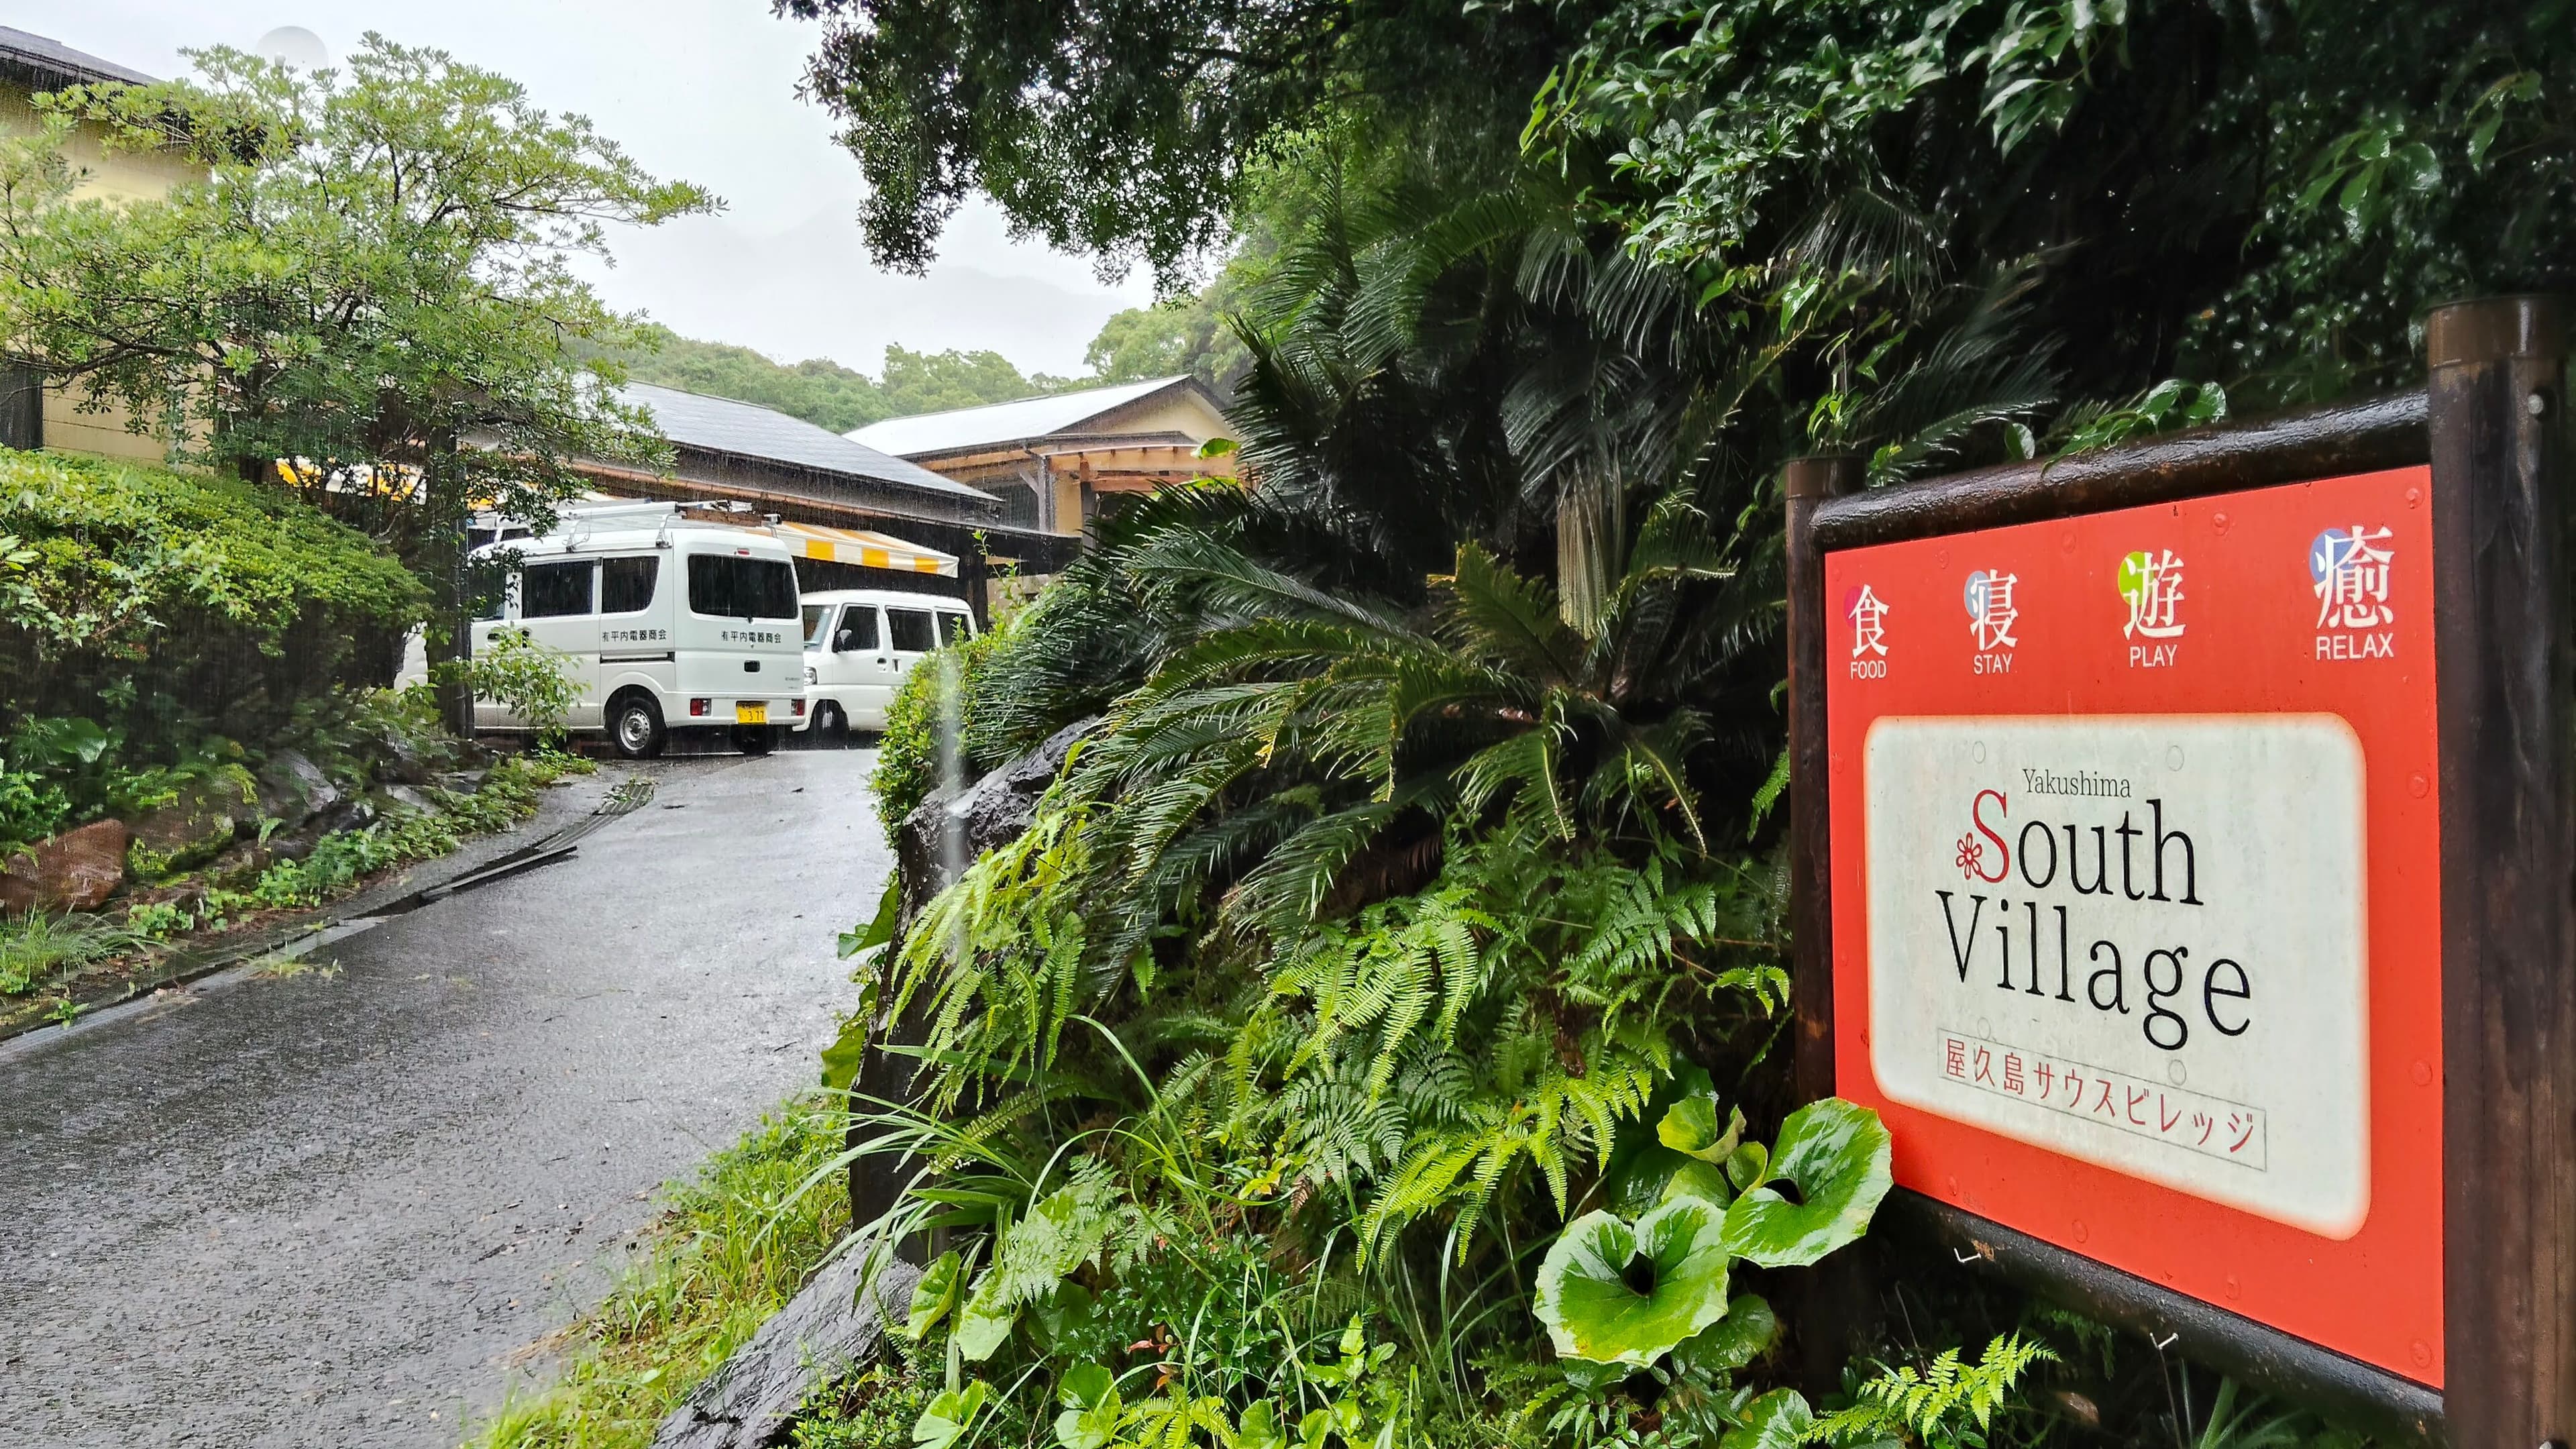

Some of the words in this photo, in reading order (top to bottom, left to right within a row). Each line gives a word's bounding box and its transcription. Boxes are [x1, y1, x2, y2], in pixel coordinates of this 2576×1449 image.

[1969, 568, 2019, 651] 寝
[2123, 548, 2187, 641] 遊
[2313, 525, 2396, 630] 癒
[1847, 584, 1890, 659] 食
[2129, 643, 2178, 669] PLAY
[2315, 632, 2395, 661] RELAX
[1849, 659, 1888, 680] FOOD
[1973, 653, 2013, 676] STAY
[2022, 767, 2132, 799] Yakushima
[1956, 788, 2204, 907] South
[1935, 889, 2253, 1051] Village
[1945, 1037, 2255, 1154] 屋久島サウスビレッジ
